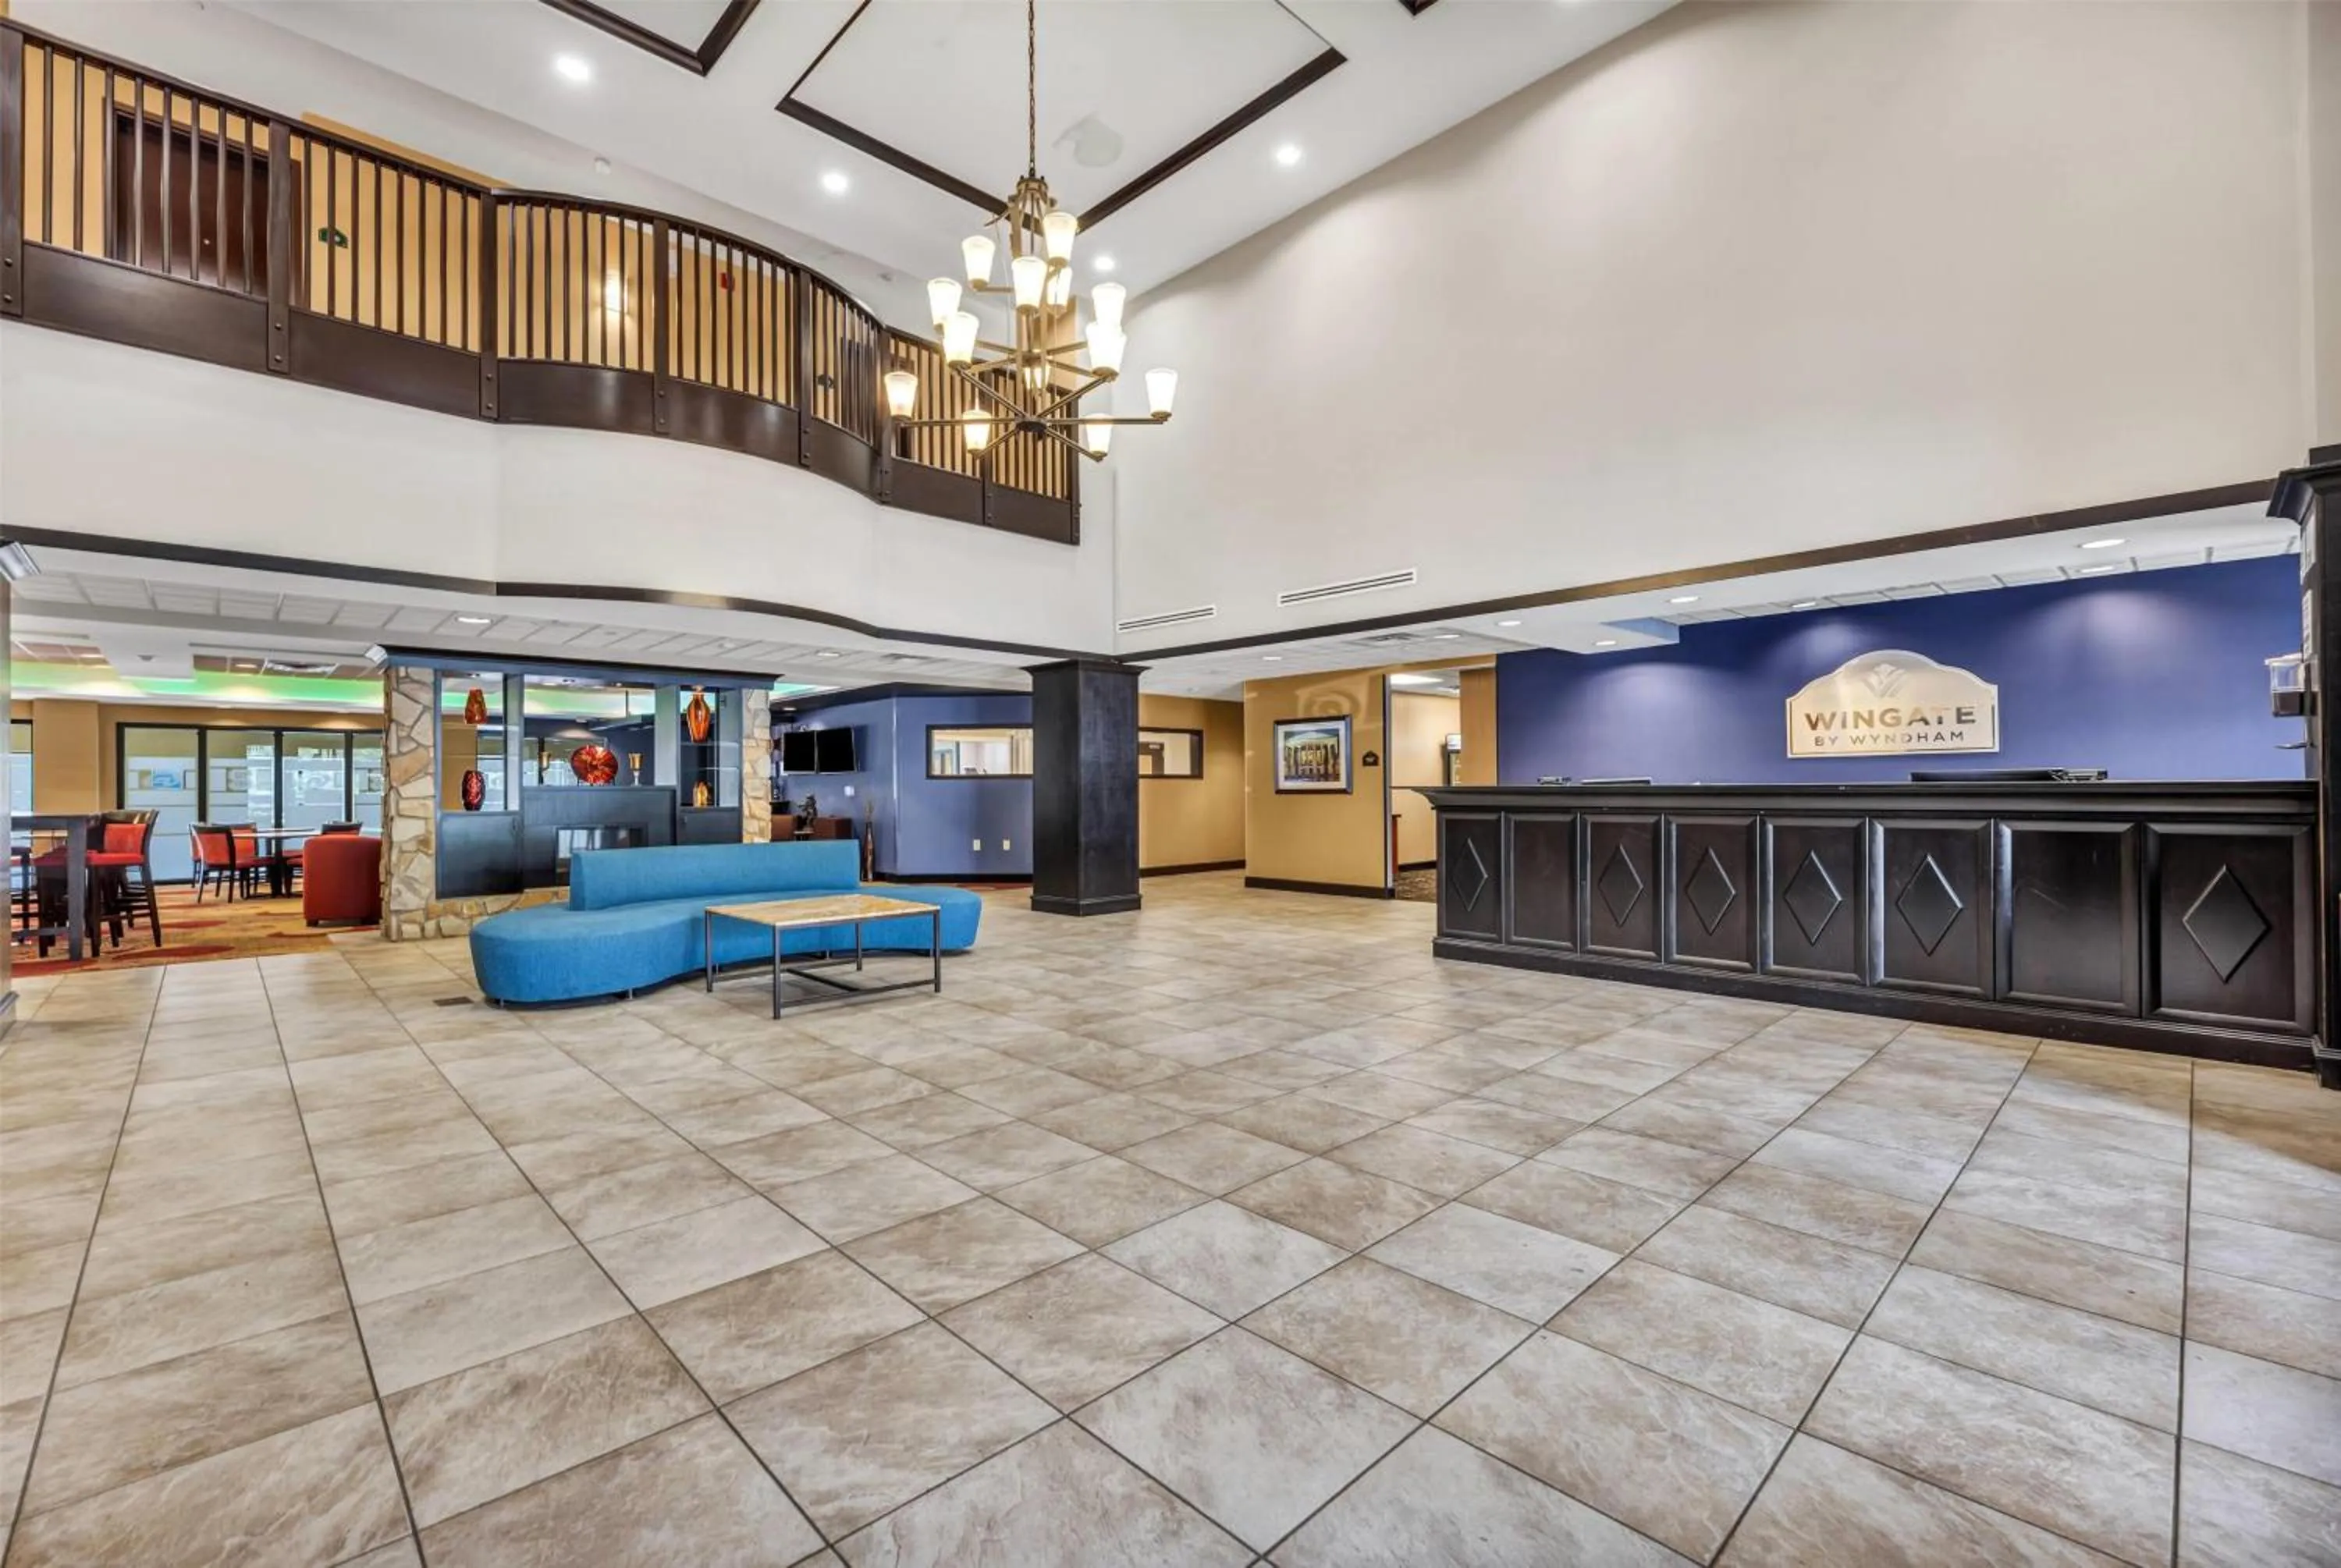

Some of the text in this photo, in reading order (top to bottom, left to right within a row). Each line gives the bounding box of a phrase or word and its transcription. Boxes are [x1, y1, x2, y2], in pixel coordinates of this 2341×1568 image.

[1804, 705, 1977, 732] WINGATE
[1814, 731, 1965, 747] BY WYNDHAM
